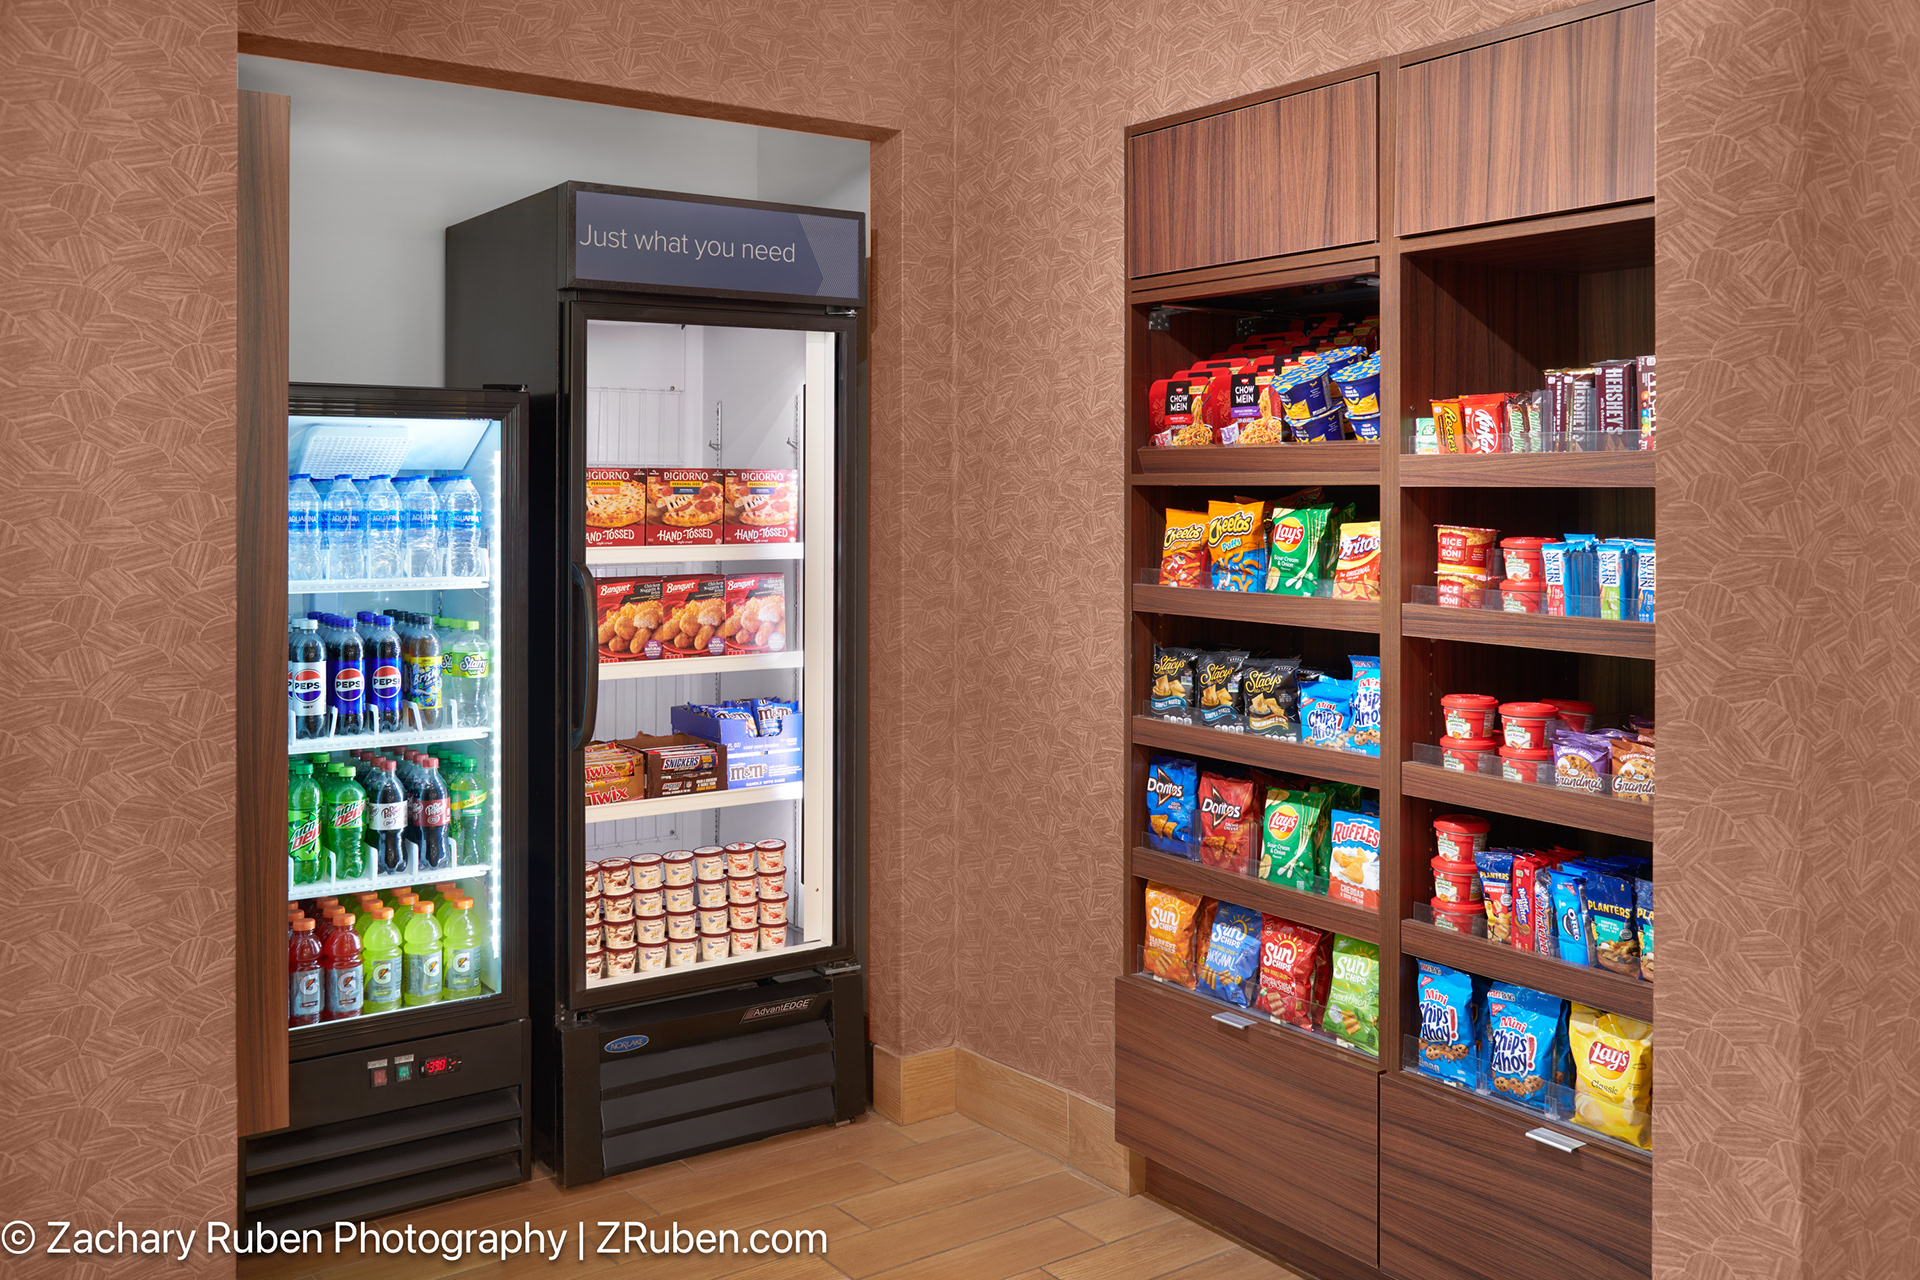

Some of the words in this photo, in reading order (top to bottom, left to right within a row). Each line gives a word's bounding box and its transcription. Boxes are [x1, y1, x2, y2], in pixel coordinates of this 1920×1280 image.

[579, 224, 628, 249] Just
[634, 230, 689, 254] what
[694, 238, 735, 260] you
[742, 243, 796, 263] need
[1170, 394, 1188, 403] CHOW
[1234, 386, 1255, 394] CHOW
[1170, 402, 1188, 412] MEIN
[1236, 394, 1254, 404] MEIN
[1605, 368, 1624, 434] HERSHEY'S
[664, 472, 708, 481] DIGIORNO
[742, 472, 784, 481] DIGIORNO
[586, 528, 634, 544] AND-TOSSED
[656, 527, 714, 541] HAND-TOSSED
[735, 526, 788, 541] HAND-TOSSED
[1164, 524, 1204, 548] Cheetos
[1208, 512, 1253, 544] Cheetos
[1276, 524, 1304, 545] Lay's
[1222, 538, 1241, 552] Puffs
[1340, 535, 1380, 559] Fritos
[1442, 538, 1462, 546] RICE
[1442, 549, 1462, 558] RONI
[1546, 552, 1554, 582] GRAIN
[1552, 552, 1560, 582] NUTRI
[1601, 553, 1610, 584] GRAIN
[1608, 553, 1616, 584] NUTRI
[1646, 556, 1654, 588] NUTRI
[600, 583, 630, 596] Banquet
[666, 582, 696, 593] Banquet
[727, 578, 756, 590] Banquet
[1440, 584, 1459, 593] RICE
[1440, 596, 1458, 605] RONI
[1154, 655, 1186, 676] Stacy's
[1200, 663, 1234, 684] Stacy's
[294, 682, 322, 690] PEPS
[1245, 670, 1282, 694] Stacy's
[1359, 678, 1380, 688] Min
[1316, 702, 1336, 710] Mini
[1308, 710, 1337, 727] Chips
[1354, 708, 1380, 726] Aho
[585, 764, 615, 778] Twix
[664, 757, 699, 768] SNICKERS
[1147, 777, 1184, 798] Doritos
[1555, 774, 1604, 792] Grandma's
[586, 786, 628, 806] Twix
[1202, 798, 1242, 818] Doritos
[1270, 813, 1298, 832] Lay's
[1332, 822, 1380, 848] RUFFLES
[1277, 844, 1290, 852] Cream
[1480, 870, 1510, 880] PLANTERS
[1340, 884, 1364, 899] CHEDDAR
[1485, 886, 1505, 894] PEANUTS
[1518, 887, 1530, 913] Nutter
[1149, 906, 1179, 929] Sun
[1516, 898, 1528, 924] Butter
[1588, 900, 1630, 919] PLANTERS
[1158, 922, 1176, 934] CHIPS
[1211, 922, 1245, 942] Sun
[1567, 908, 1579, 941] OREO
[1220, 936, 1241, 948] CHIPS
[1206, 949, 1235, 971] ORIGINAL
[1264, 942, 1295, 966] Sun
[1272, 960, 1291, 972] CHIPS
[1334, 956, 1370, 979] Sun
[1345, 973, 1366, 985] CHIPS
[1425, 988, 1448, 1005] Mini
[753, 1000, 810, 1016] AdvantEDGE
[1420, 1002, 1449, 1026] Chips
[1500, 1016, 1526, 1033] Mini
[610, 1038, 644, 1050] NORLAKE
[1494, 1030, 1528, 1054] Chips
[1590, 1042, 1628, 1071] Lay's
[1590, 1080, 1618, 1095] Classic
